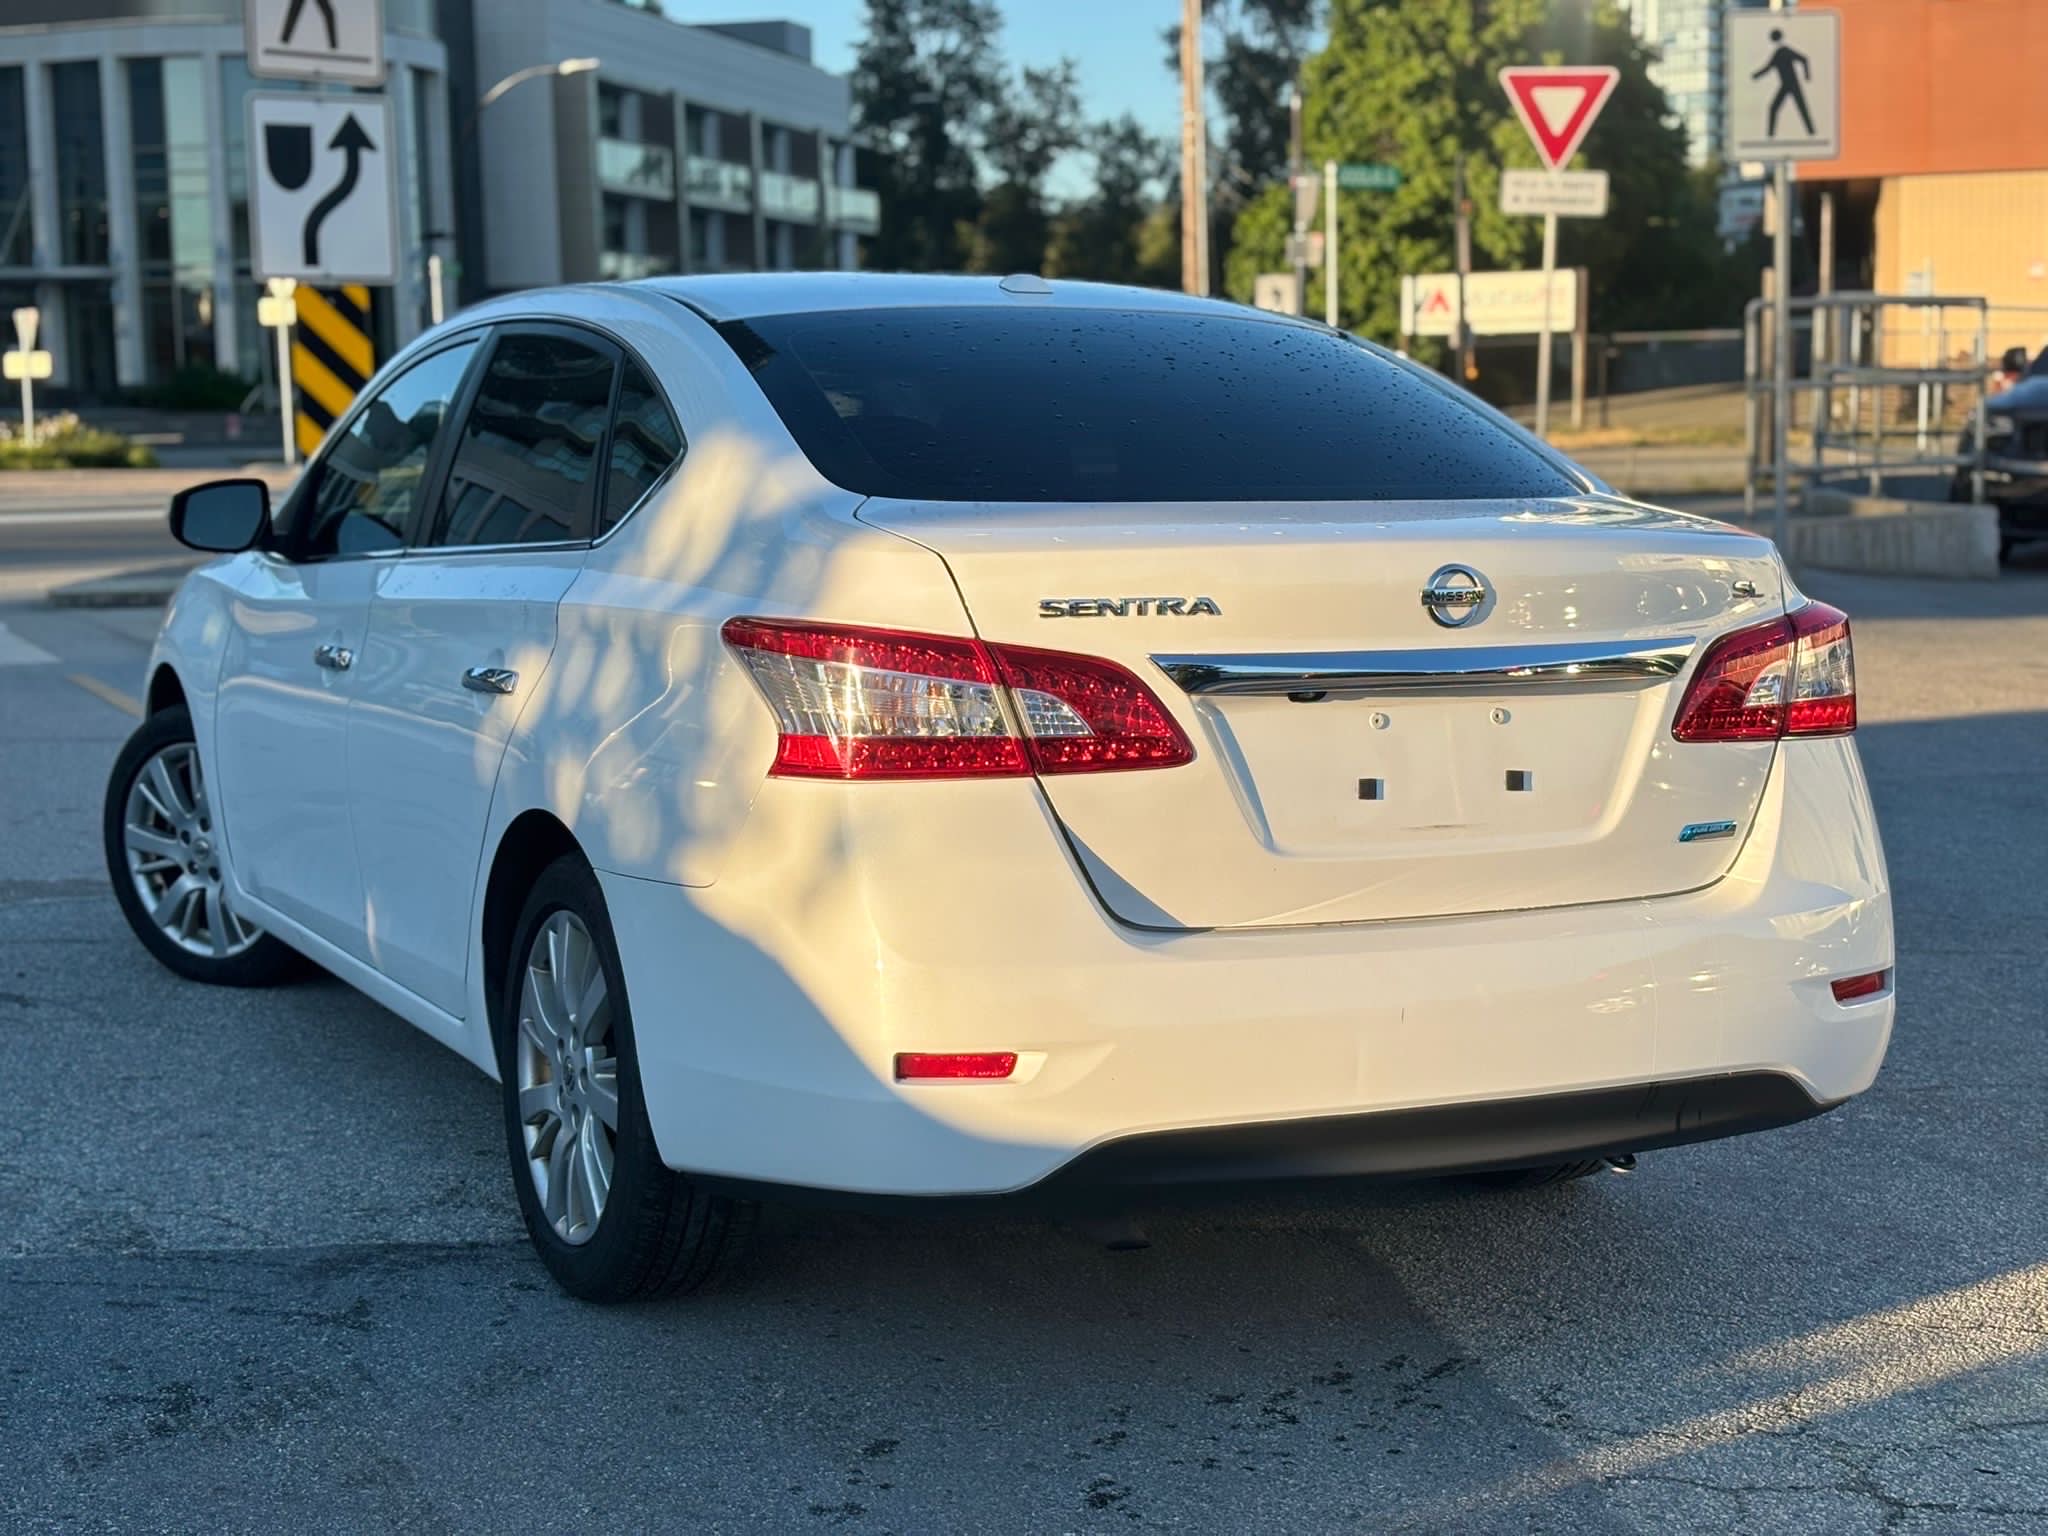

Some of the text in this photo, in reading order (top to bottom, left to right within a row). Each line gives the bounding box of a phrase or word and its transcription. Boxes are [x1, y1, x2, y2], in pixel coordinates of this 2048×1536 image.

[1431, 590, 1481, 602] NISSAN
[1732, 580, 1765, 598] SL
[1039, 597, 1222, 618] SENTRA
